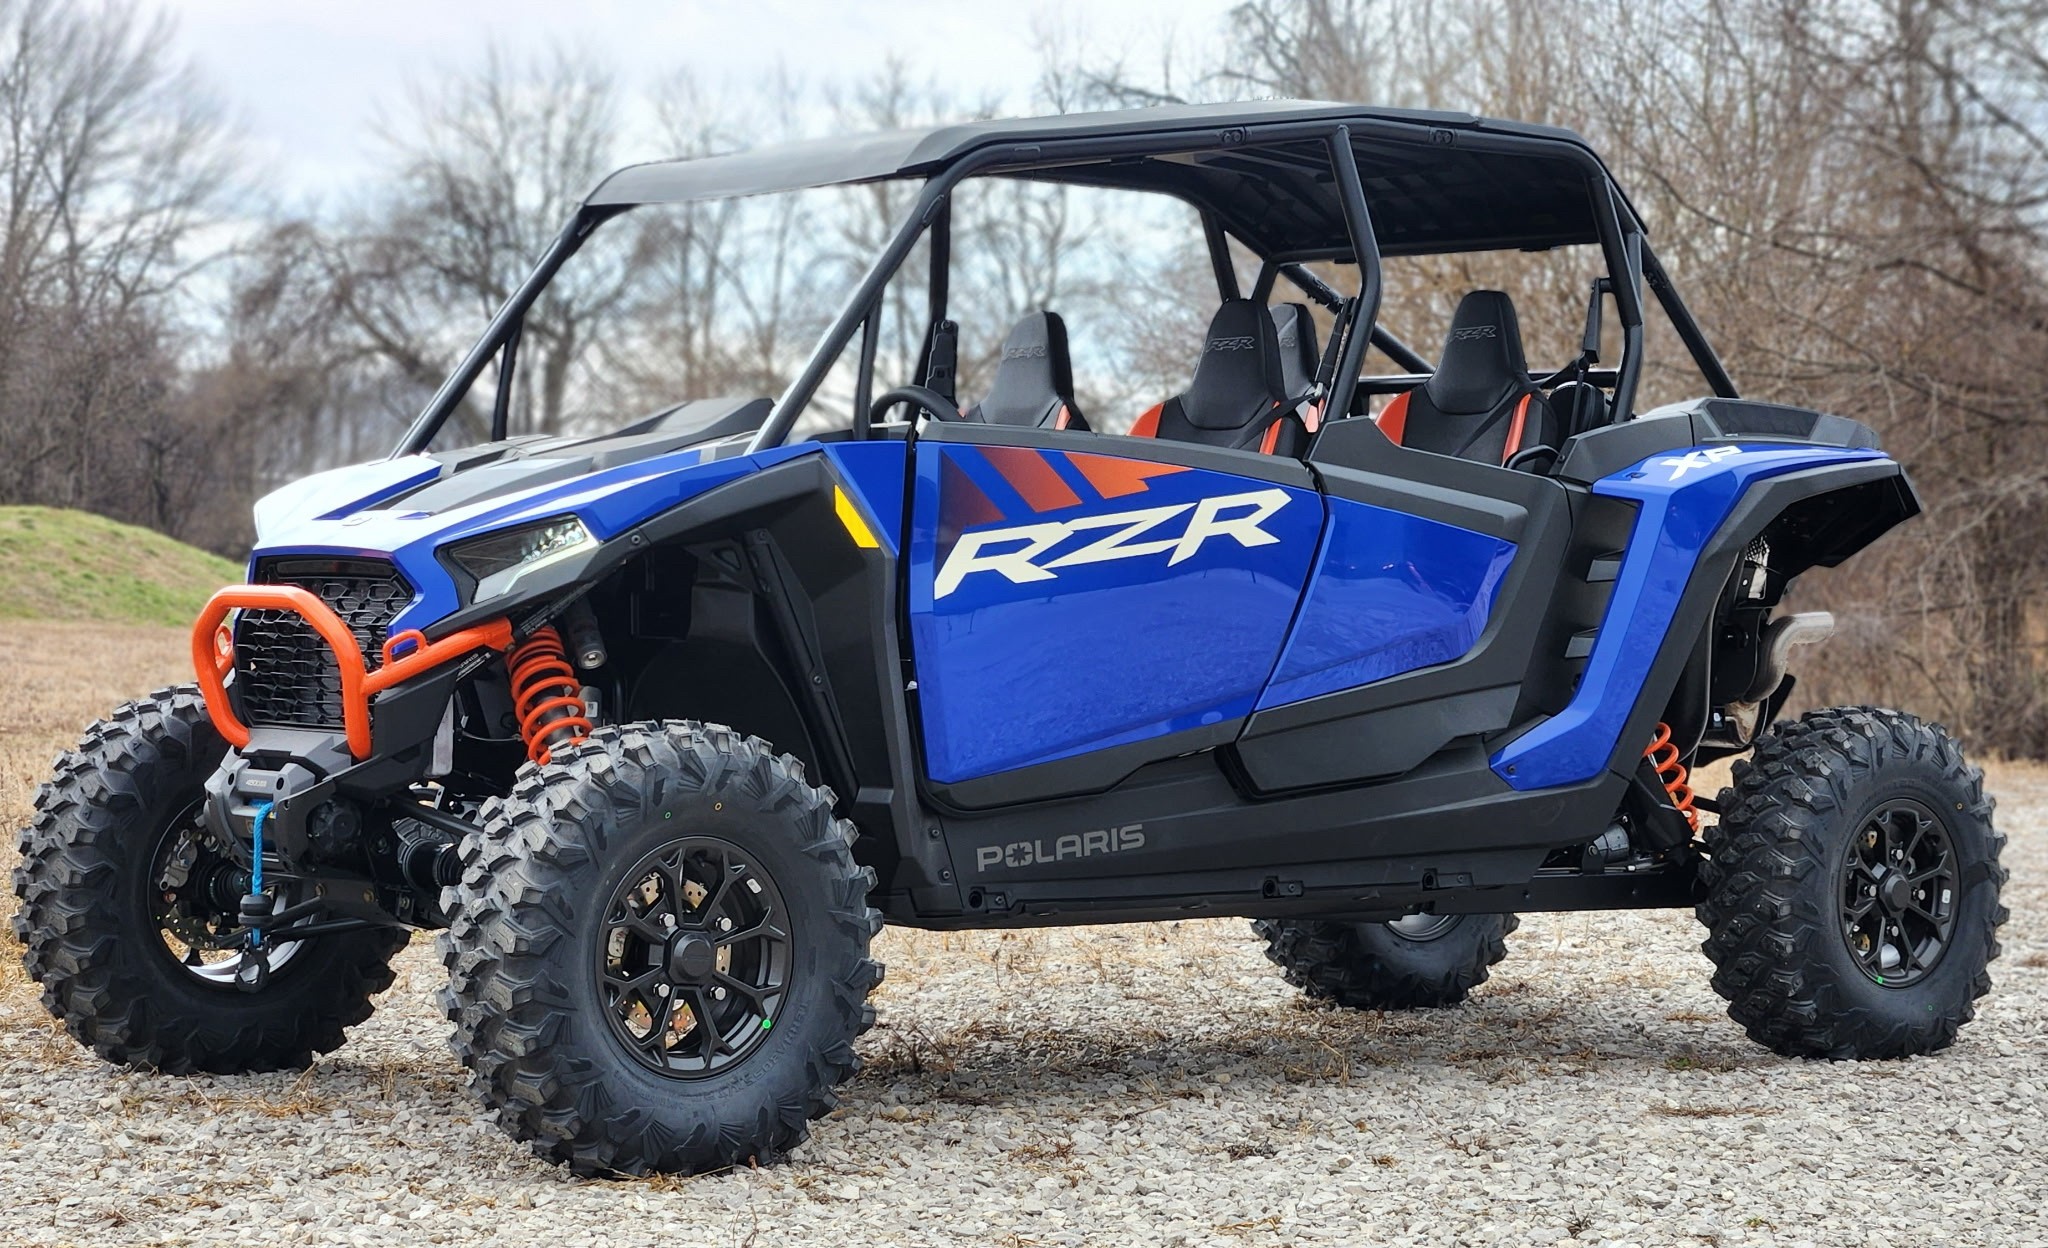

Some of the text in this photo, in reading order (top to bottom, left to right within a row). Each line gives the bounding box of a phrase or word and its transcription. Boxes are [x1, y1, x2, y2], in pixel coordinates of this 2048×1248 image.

[1206, 336, 1255, 352] RZR
[1449, 325, 1497, 343] RZR
[1002, 345, 1046, 362] RZR
[1660, 445, 1743, 481] XP
[934, 488, 1293, 600] RZR
[976, 823, 1146, 872] POLARIS
